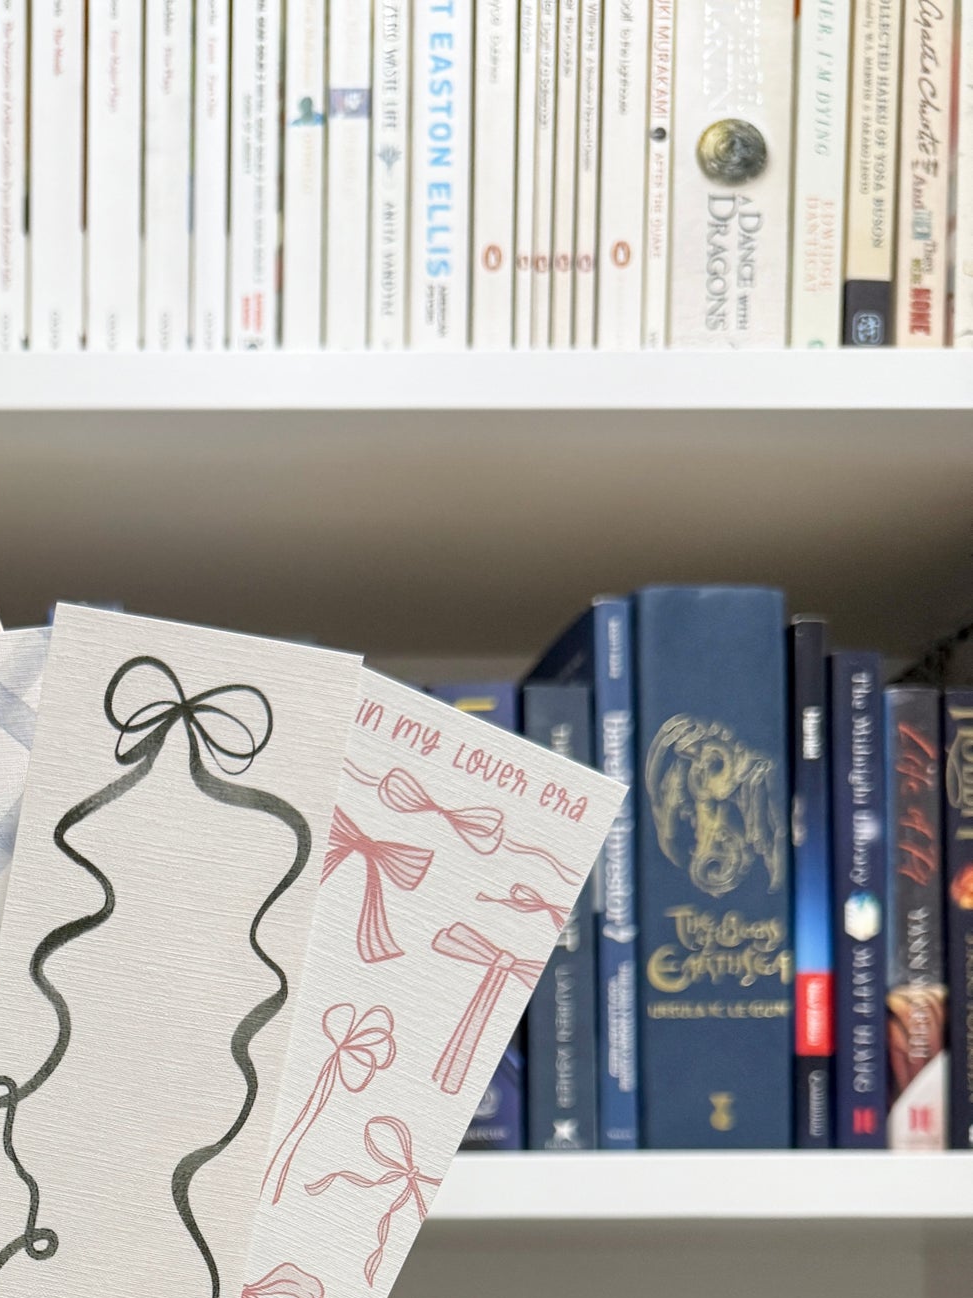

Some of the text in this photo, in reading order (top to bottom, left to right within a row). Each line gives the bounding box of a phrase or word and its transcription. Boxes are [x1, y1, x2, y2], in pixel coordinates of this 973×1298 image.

[653, 26, 670, 119] MURAKAMI
[428, 32, 455, 278] EASTON ELLIS
[814, 91, 832, 157] DYING
[910, 0, 944, 337] Agatha Christie And NONE
[705, 193, 737, 332] DRAGONS
[736, 212, 763, 288] DANCE
[851, 672, 872, 709] The
[355, 697, 588, 823] in my Lover era
[848, 715, 873, 805] Midnight
[895, 722, 939, 796] Life
[907, 907, 931, 969] YANN
[554, 965, 573, 1043] LAUREN
[852, 946, 876, 1093] MATT HAIG
